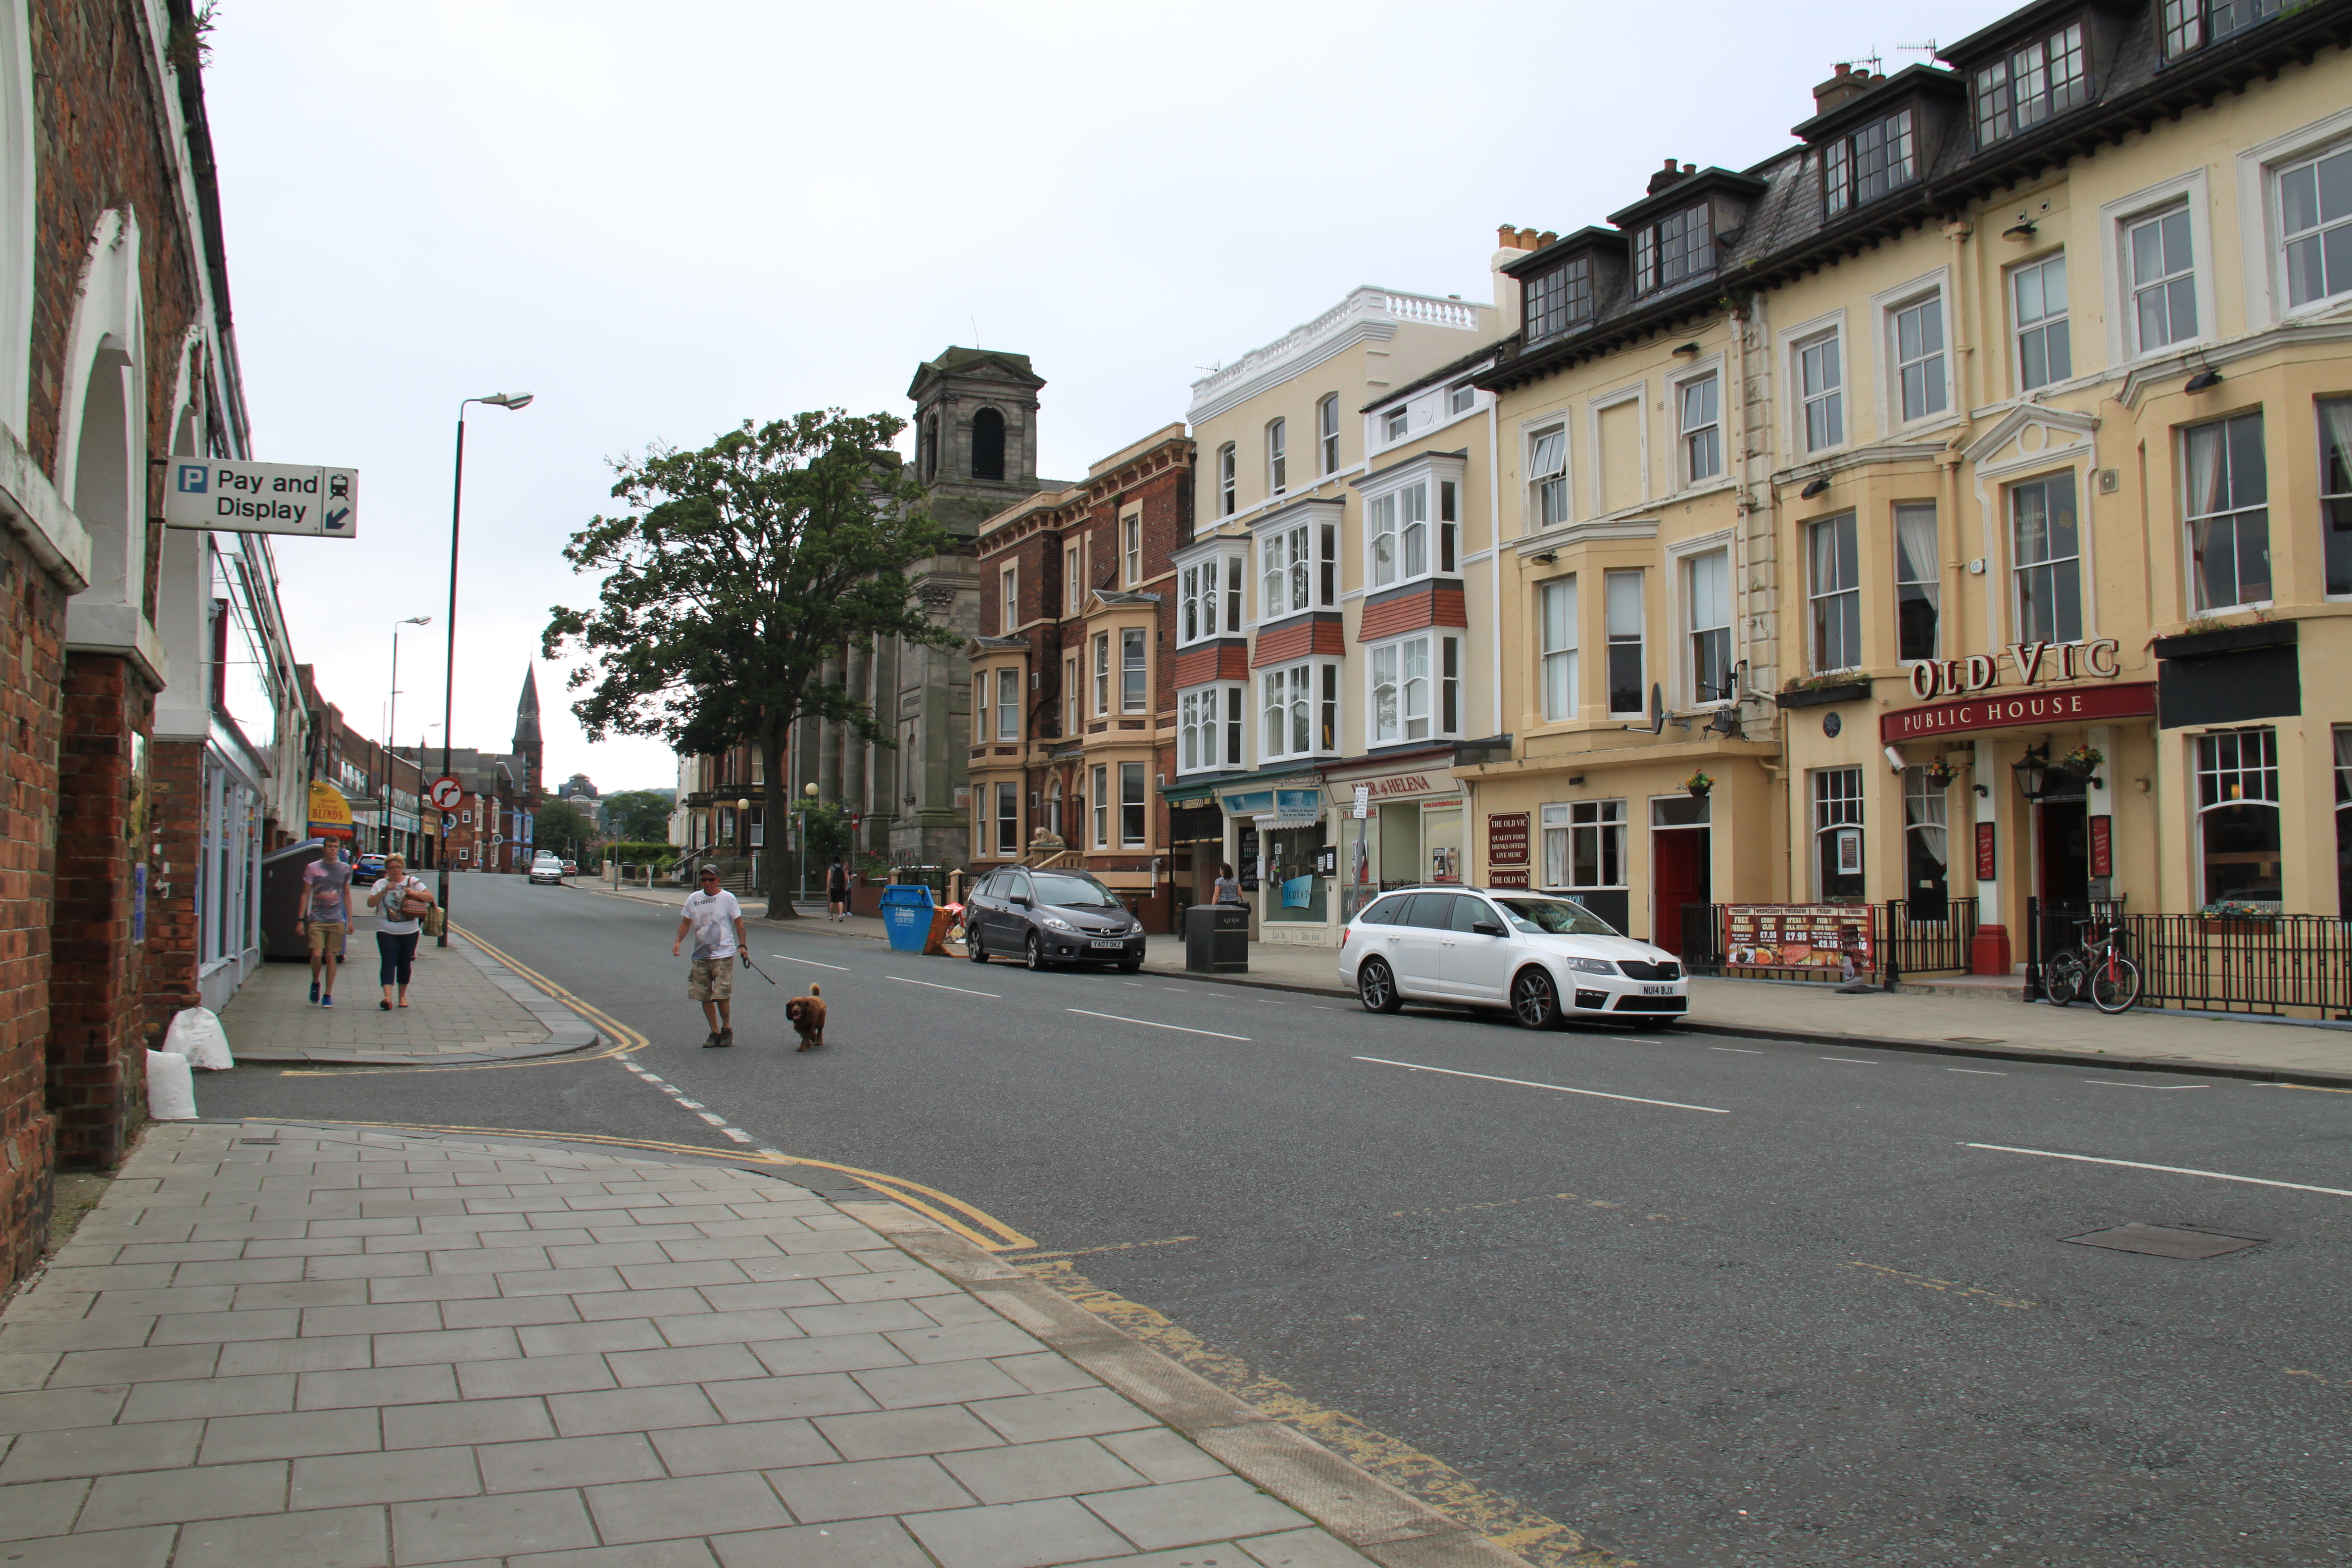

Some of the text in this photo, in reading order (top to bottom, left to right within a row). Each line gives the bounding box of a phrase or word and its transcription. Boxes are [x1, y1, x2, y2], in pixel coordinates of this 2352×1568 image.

[185, 468, 318, 494] P Pay and
[217, 496, 307, 523] Display
[1910, 638, 2120, 701] OLD VIC
[1904, 696, 2082, 732] PUBLIC HOUSE
[1386, 776, 1430, 793] HELENA
[312, 808, 343, 820] BLINDS
[1281, 886, 1311, 900] Chambers
[1280, 931, 1286, 939] In
[1301, 931, 1320, 941] Take Out
[1785, 932, 1807, 941] £7.95
[1818, 940, 1838, 948] £9.95
[1859, 941, 1867, 950] 10
[1643, 986, 1673, 994] NU14 BJX
